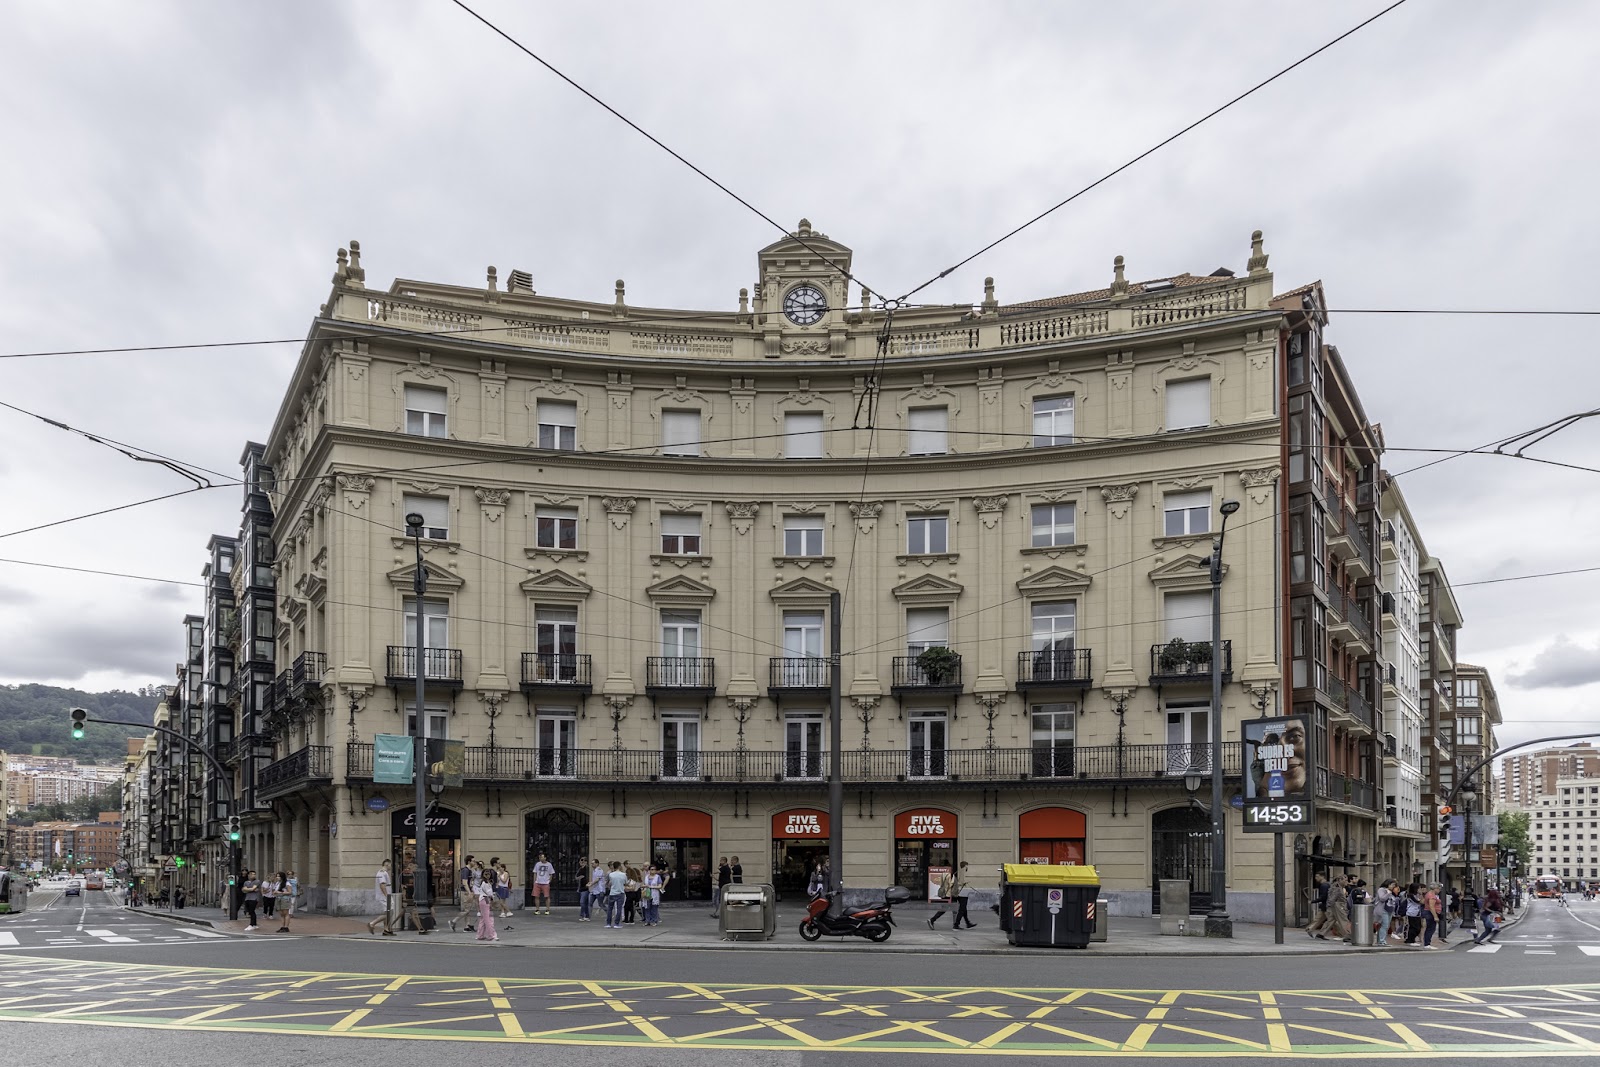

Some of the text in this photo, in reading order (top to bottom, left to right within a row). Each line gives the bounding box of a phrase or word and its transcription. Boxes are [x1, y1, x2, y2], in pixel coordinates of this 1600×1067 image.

[1258, 744, 1295, 760] SUDAR ES
[1264, 758, 1288, 772] BELLO
[404, 813, 448, 826] Eam
[1250, 805, 1303, 823] 14:53
[788, 815, 818, 825] FIVE
[911, 815, 941, 825] FIVE
[785, 825, 821, 834] GUYS
[907, 825, 944, 834] GUYS
